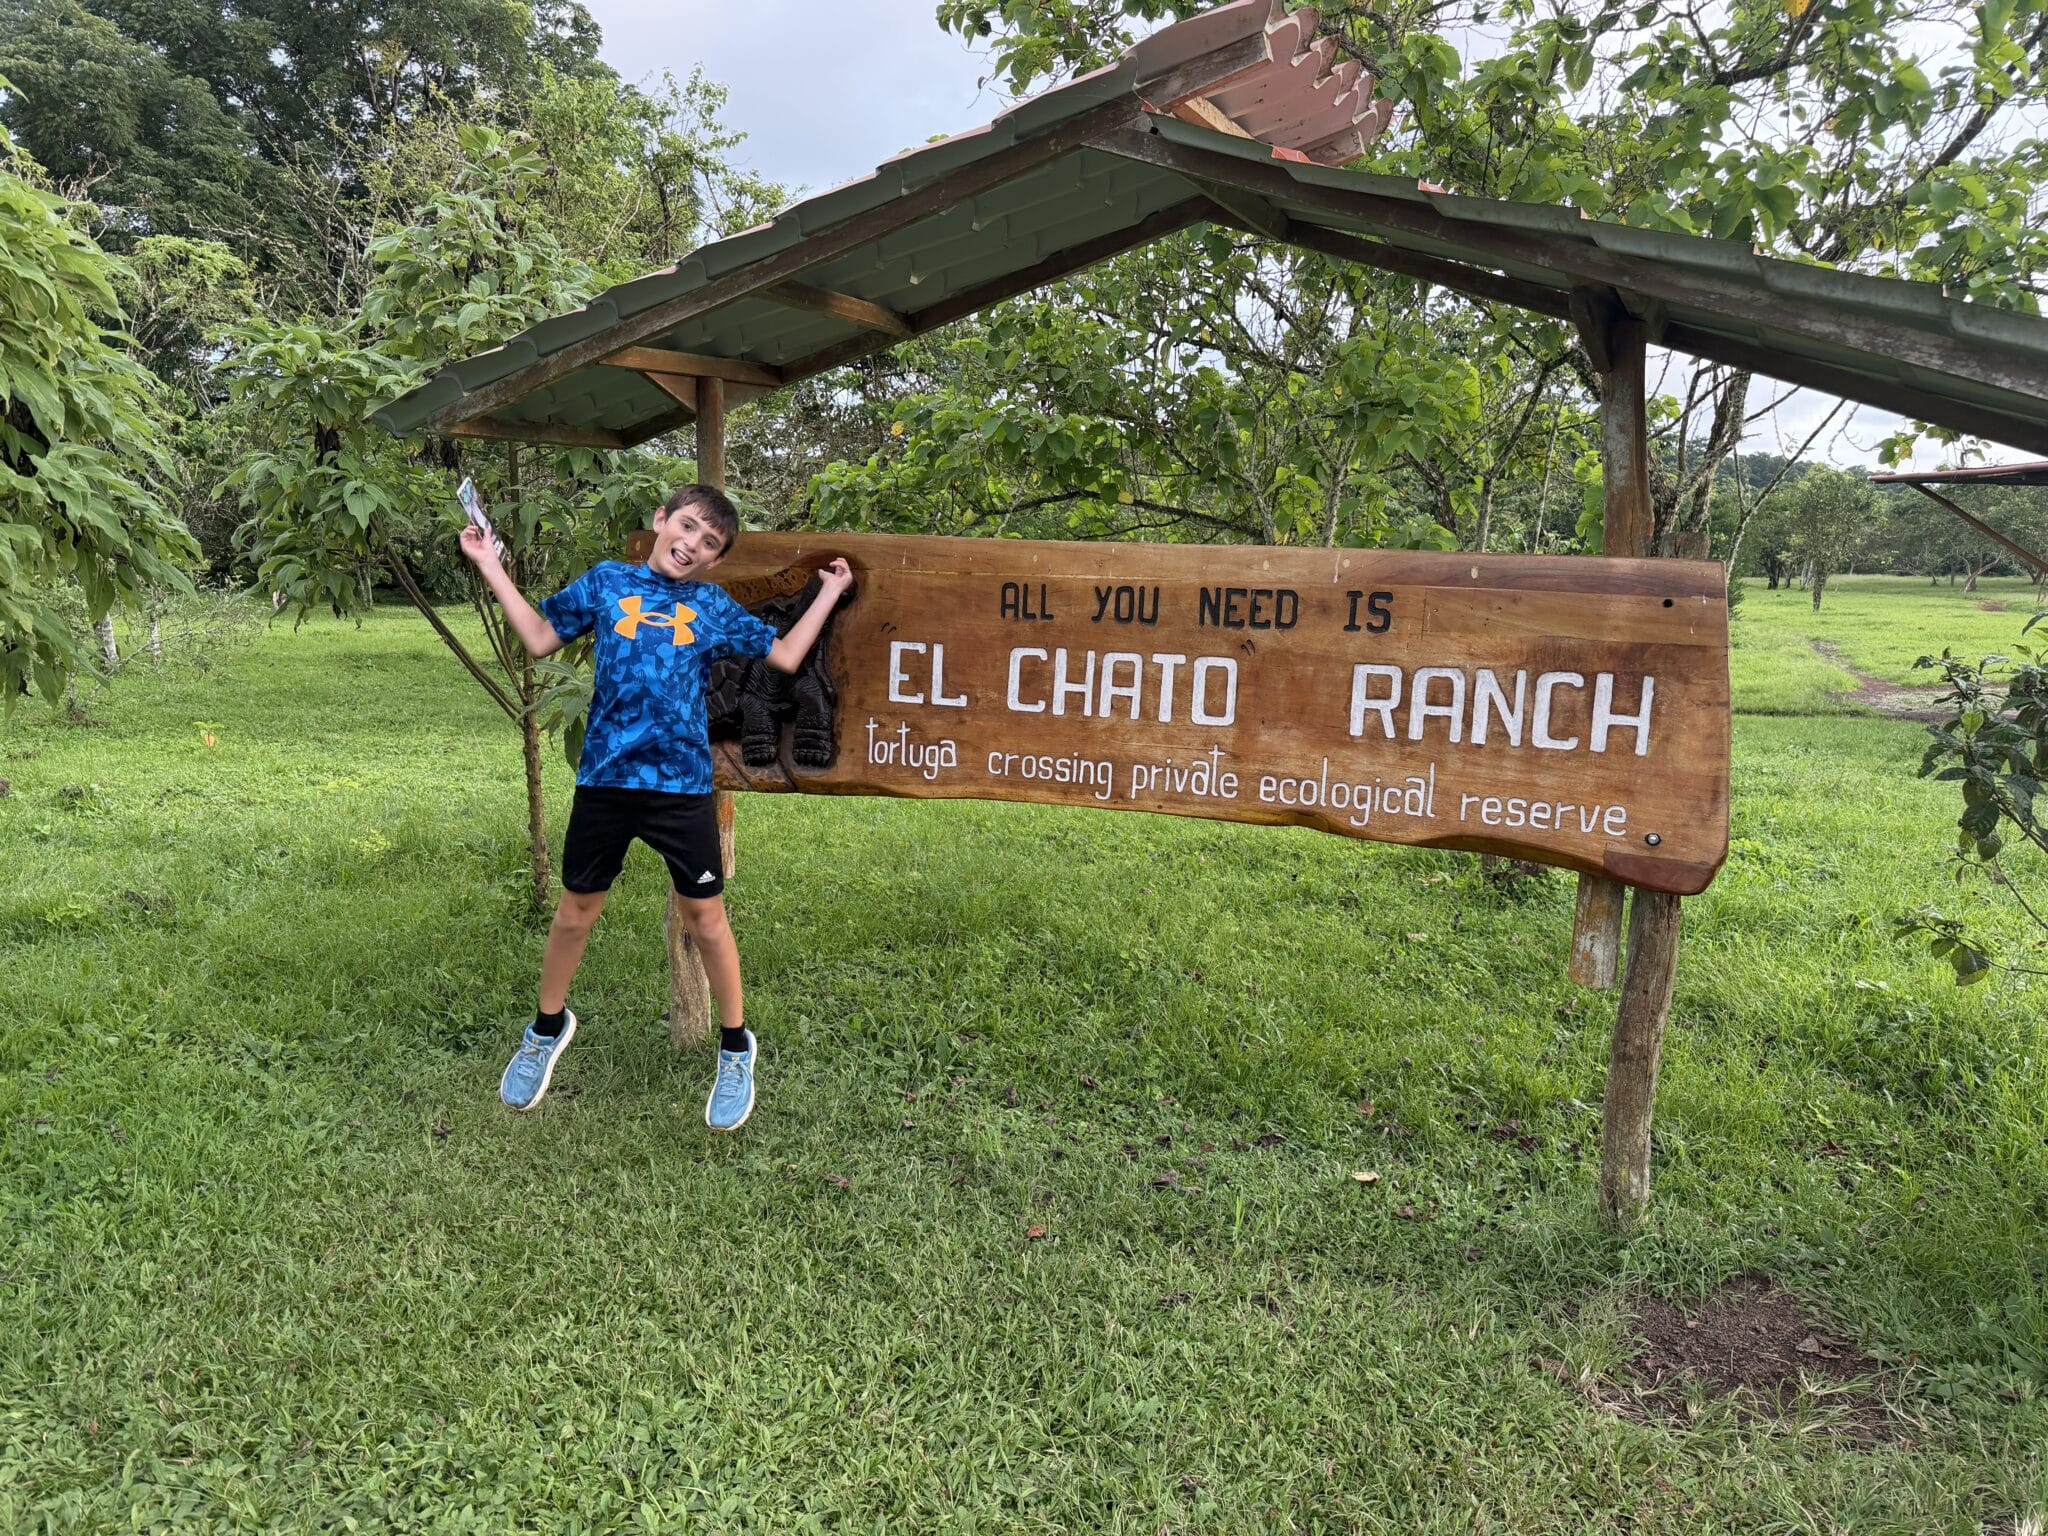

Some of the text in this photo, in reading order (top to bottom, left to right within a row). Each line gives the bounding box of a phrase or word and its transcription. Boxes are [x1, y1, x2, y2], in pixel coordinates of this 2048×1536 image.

[1000, 582, 1394, 634] ALL YOU NEED IS
[1349, 663, 1655, 757] RANCH
[865, 716, 1628, 836] tortuga crossing private ecological reserve
